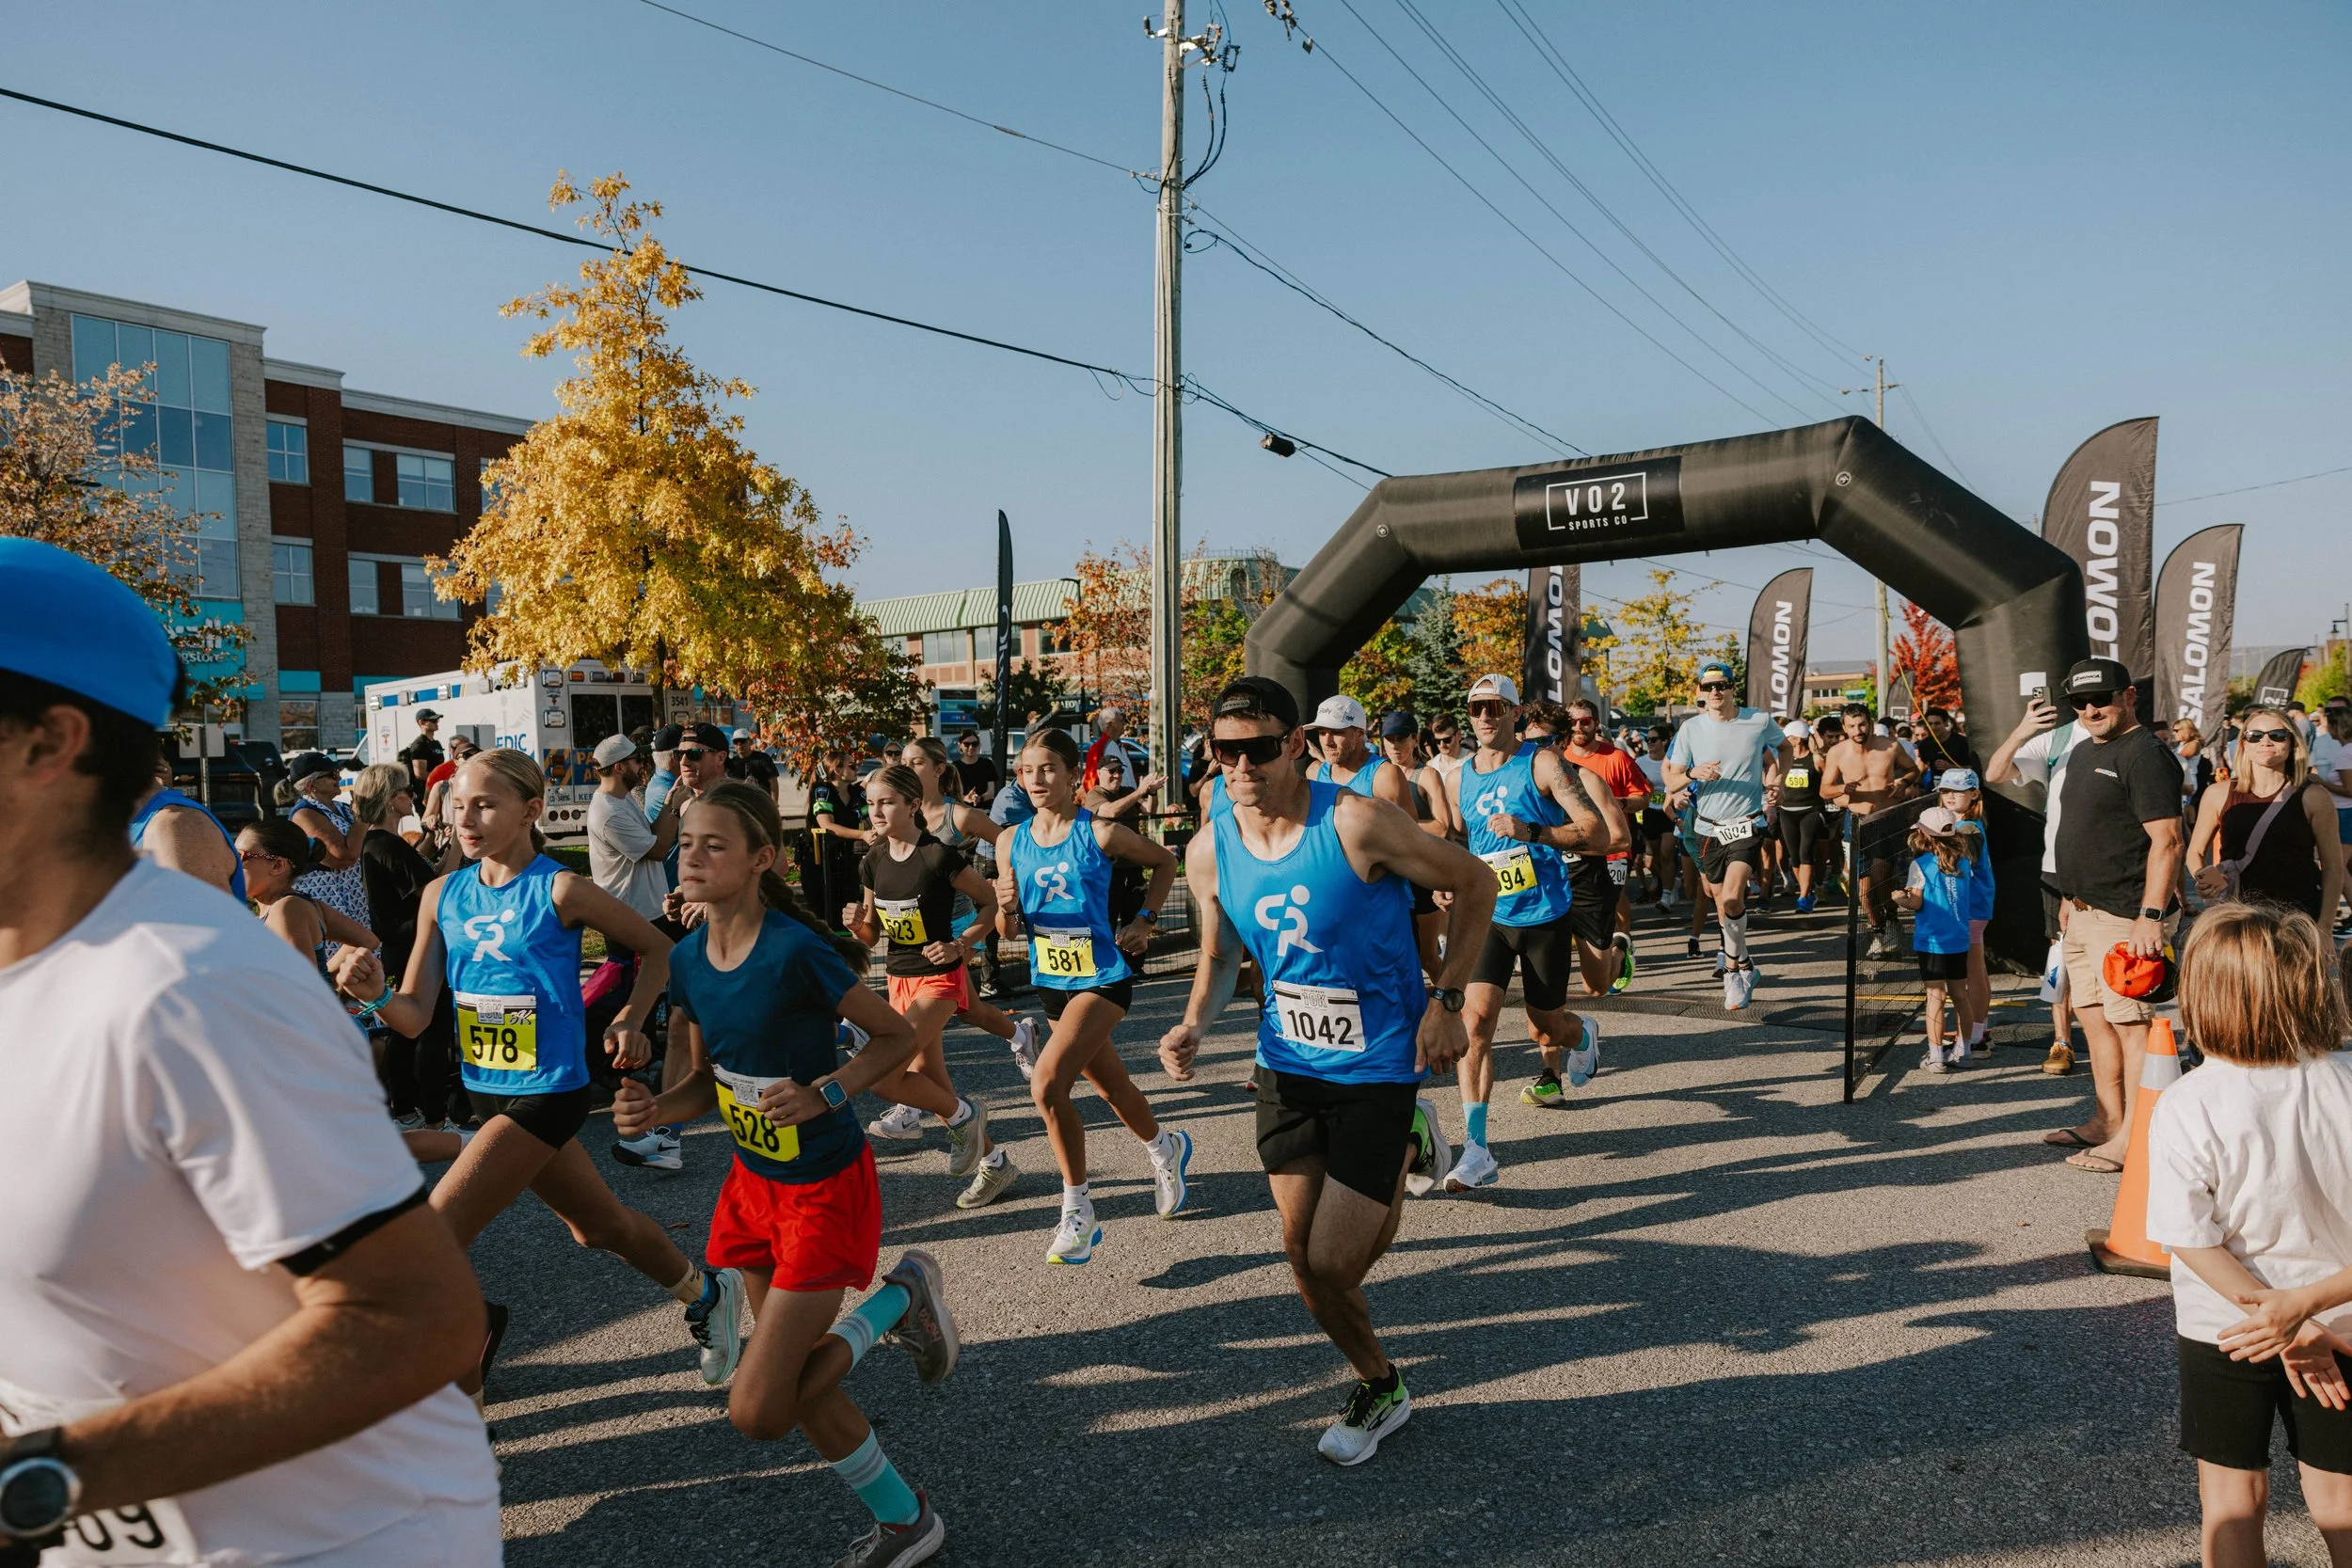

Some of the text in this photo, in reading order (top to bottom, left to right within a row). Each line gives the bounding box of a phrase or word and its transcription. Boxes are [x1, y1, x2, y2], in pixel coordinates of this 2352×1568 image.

[1565, 483, 1626, 515] VO2
[1568, 515, 1627, 531] SPORTS CO
[2178, 561, 2217, 730] SALOMON
[671, 696, 689, 706] 3541
[1789, 777, 1804, 786] 590
[885, 918, 914, 941] 523
[1047, 948, 1081, 972] 581
[1302, 992, 1327, 1008] 10K
[509, 1009, 532, 1025] 5K
[1287, 1009, 1354, 1045] 1042
[469, 1025, 518, 1063] 578
[729, 1104, 780, 1153] 528
